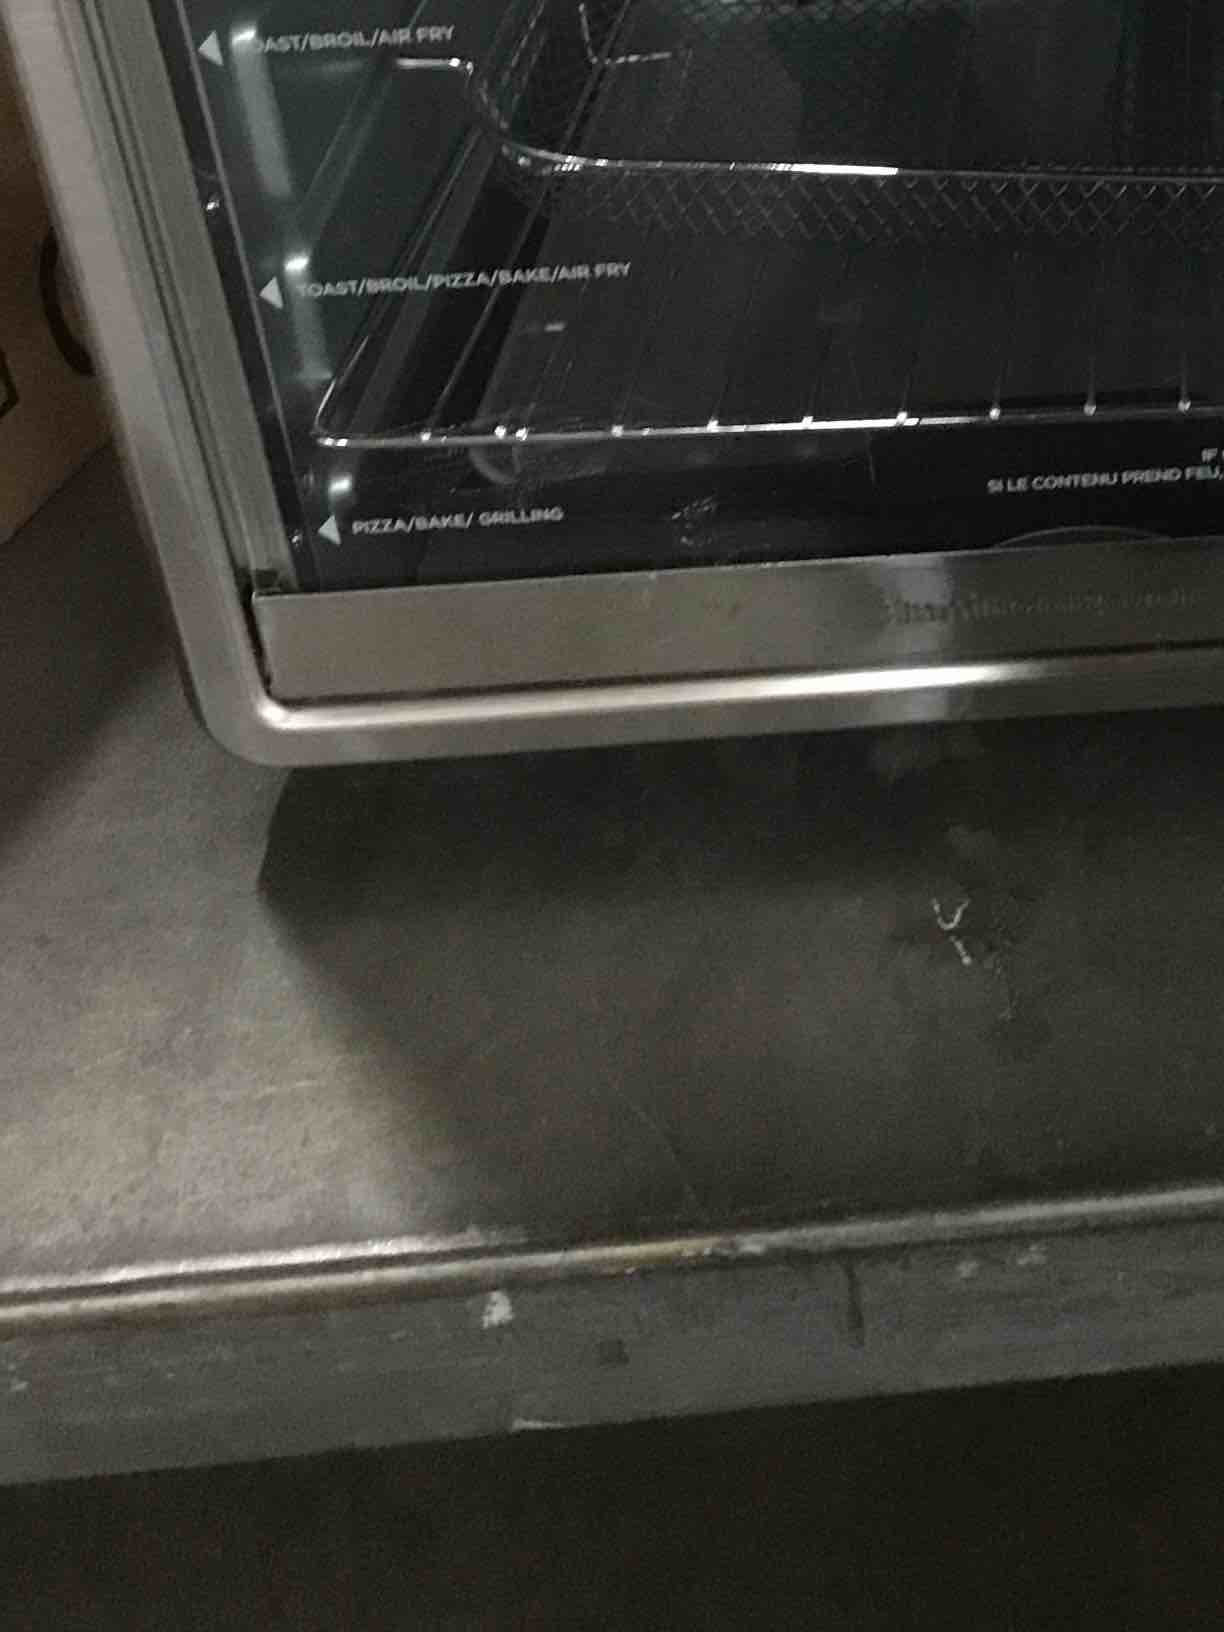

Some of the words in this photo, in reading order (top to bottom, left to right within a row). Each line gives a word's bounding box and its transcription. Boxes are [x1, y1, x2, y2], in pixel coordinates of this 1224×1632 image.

[415, 25, 456, 43] FRY
[591, 261, 631, 279] FRY
[1201, 447, 1218, 462] IF
[1007, 477, 1028, 493] LE
[1031, 471, 1118, 491] CONTENU
[1121, 467, 1183, 485] PREND
[478, 505, 565, 527] GRILLING
